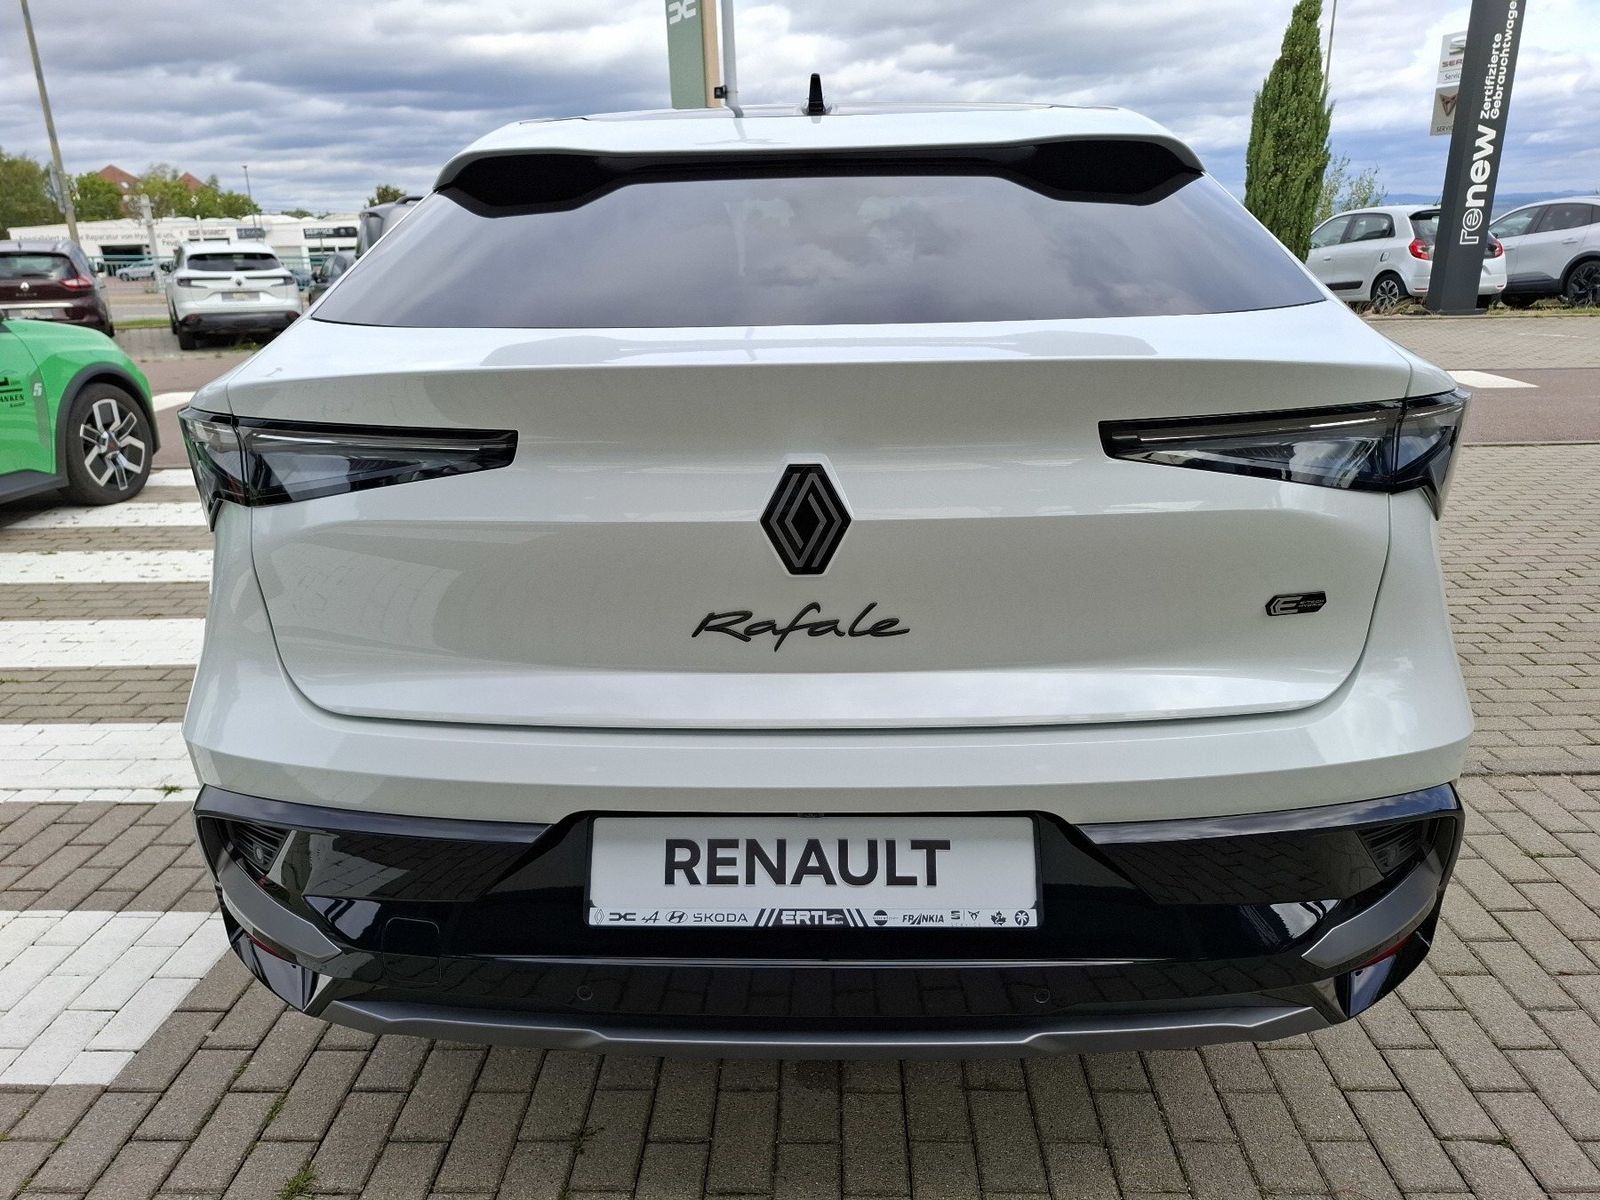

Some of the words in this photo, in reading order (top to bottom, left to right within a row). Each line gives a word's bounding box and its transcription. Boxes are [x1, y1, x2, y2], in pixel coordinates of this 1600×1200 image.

[1442, 58, 1463, 68] SEA
[1444, 71, 1460, 80] Servic
[1480, 33, 1502, 119] Zertifizierte
[1490, 0, 1518, 119] Gebrauchtwage
[1460, 124, 1497, 245] renew
[691, 601, 911, 652] Rafale
[664, 838, 951, 887] RENAULT
[902, 913, 944, 925] FRANKIA
